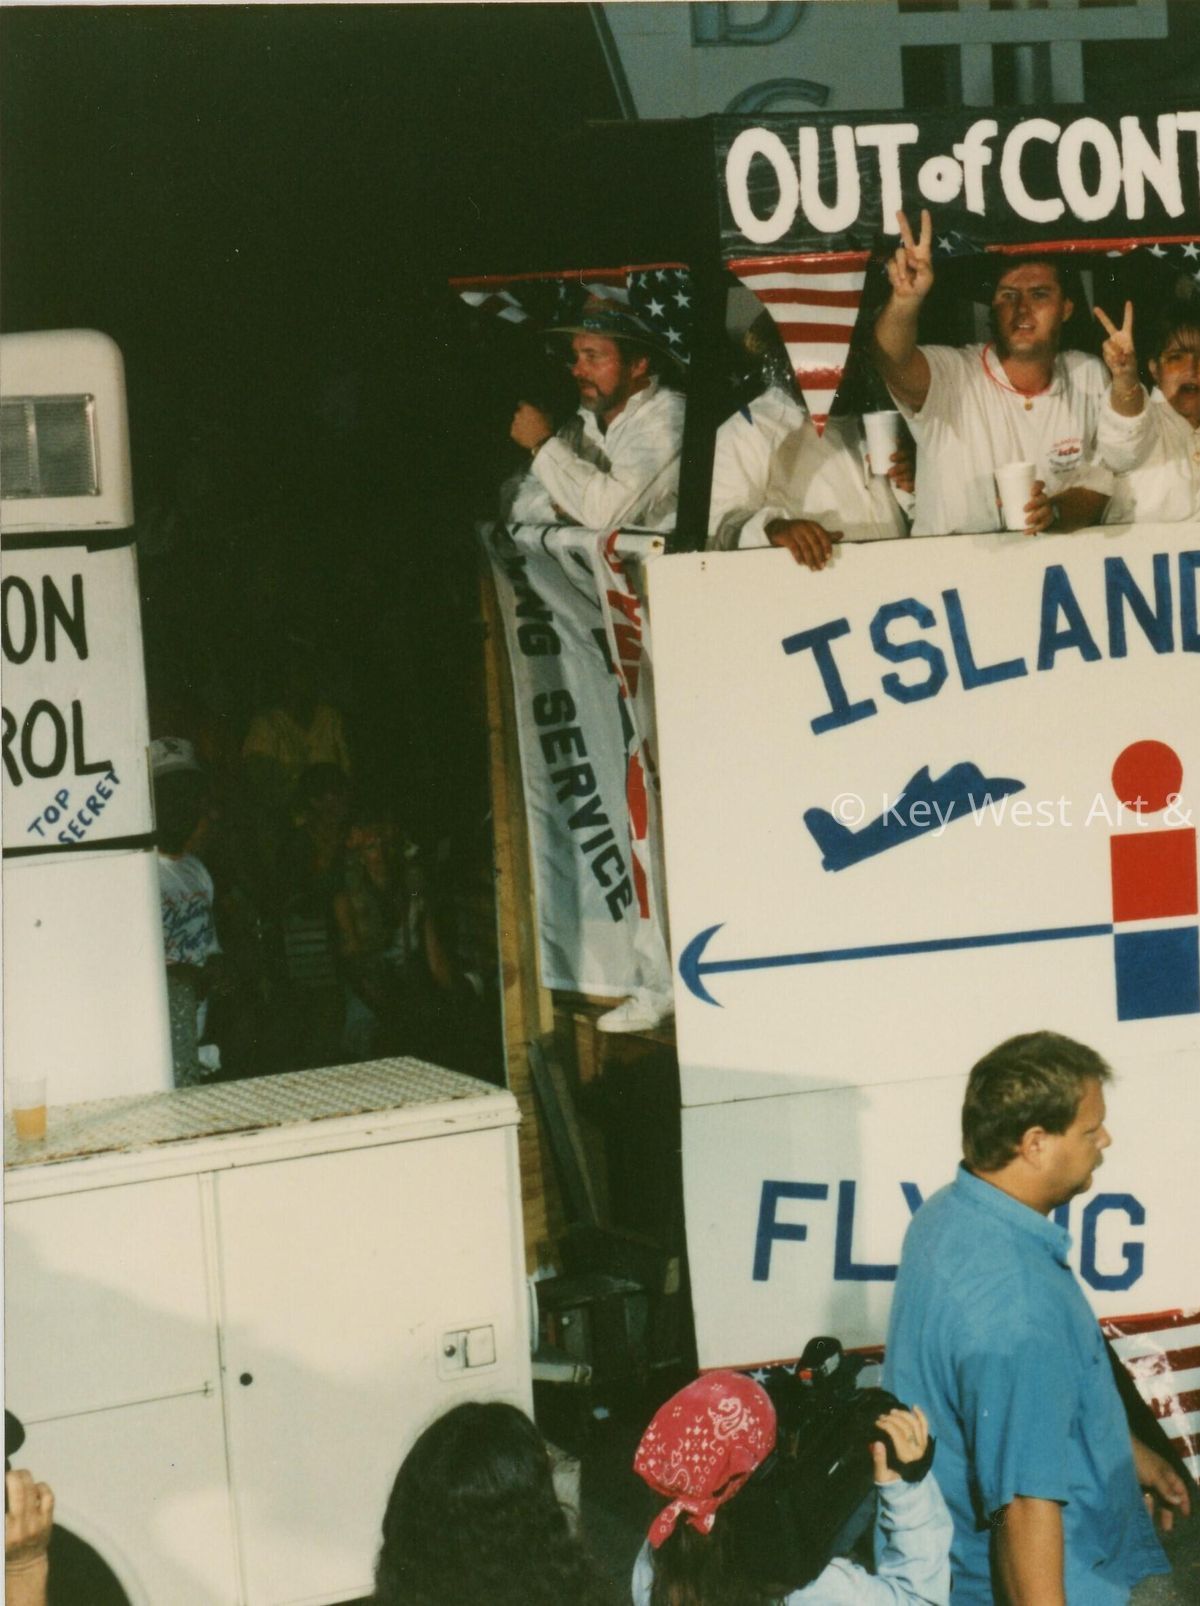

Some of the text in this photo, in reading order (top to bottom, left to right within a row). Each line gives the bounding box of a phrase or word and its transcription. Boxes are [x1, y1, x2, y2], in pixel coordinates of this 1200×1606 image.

[725, 122, 919, 244] OUT
[918, 119, 999, 217] of
[1, 573, 88, 665] ON
[27, 788, 70, 838] TOP
[57, 768, 121, 845] SECRET
[532, 689, 633, 923] SERVICE
[752, 1179, 1146, 1292] FLG
